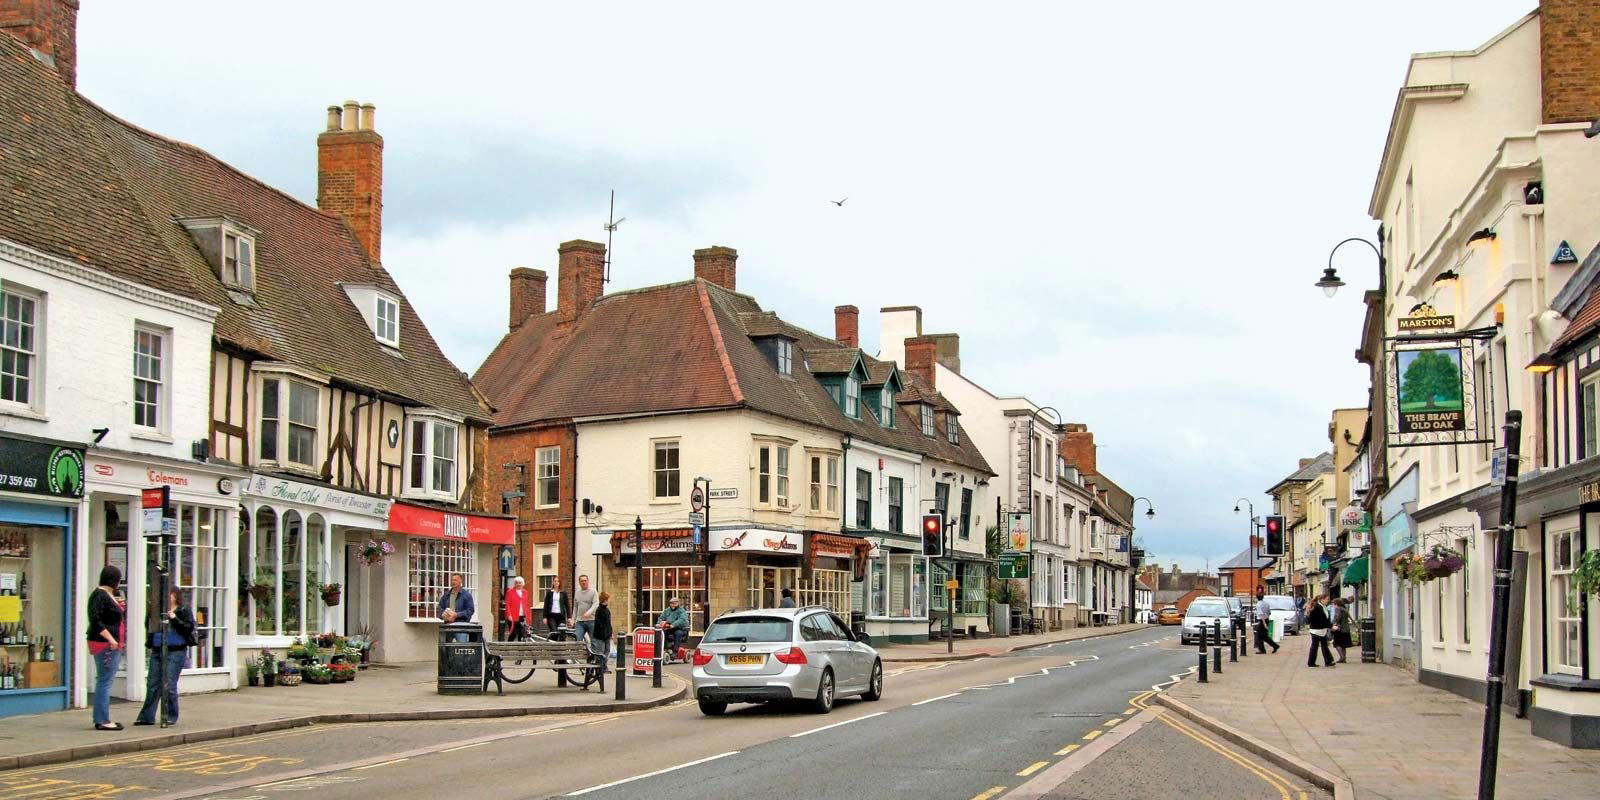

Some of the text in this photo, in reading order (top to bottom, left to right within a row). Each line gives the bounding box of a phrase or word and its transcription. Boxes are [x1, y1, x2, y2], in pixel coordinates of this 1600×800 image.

[1400, 318, 1453, 327] MARSTON'S
[1405, 412, 1459, 422] THE BRAVE
[1410, 420, 1454, 430] OLD OAK
[148, 466, 188, 486] Colemans
[8, 476, 22, 486] 359
[23, 477, 37, 487] 657
[271, 481, 300, 501] Floral
[301, 488, 320, 504] Art
[444, 514, 468, 539] TAYLORS
[1342, 518, 1363, 526] HSBC
[747, 655, 761, 663] PHN
